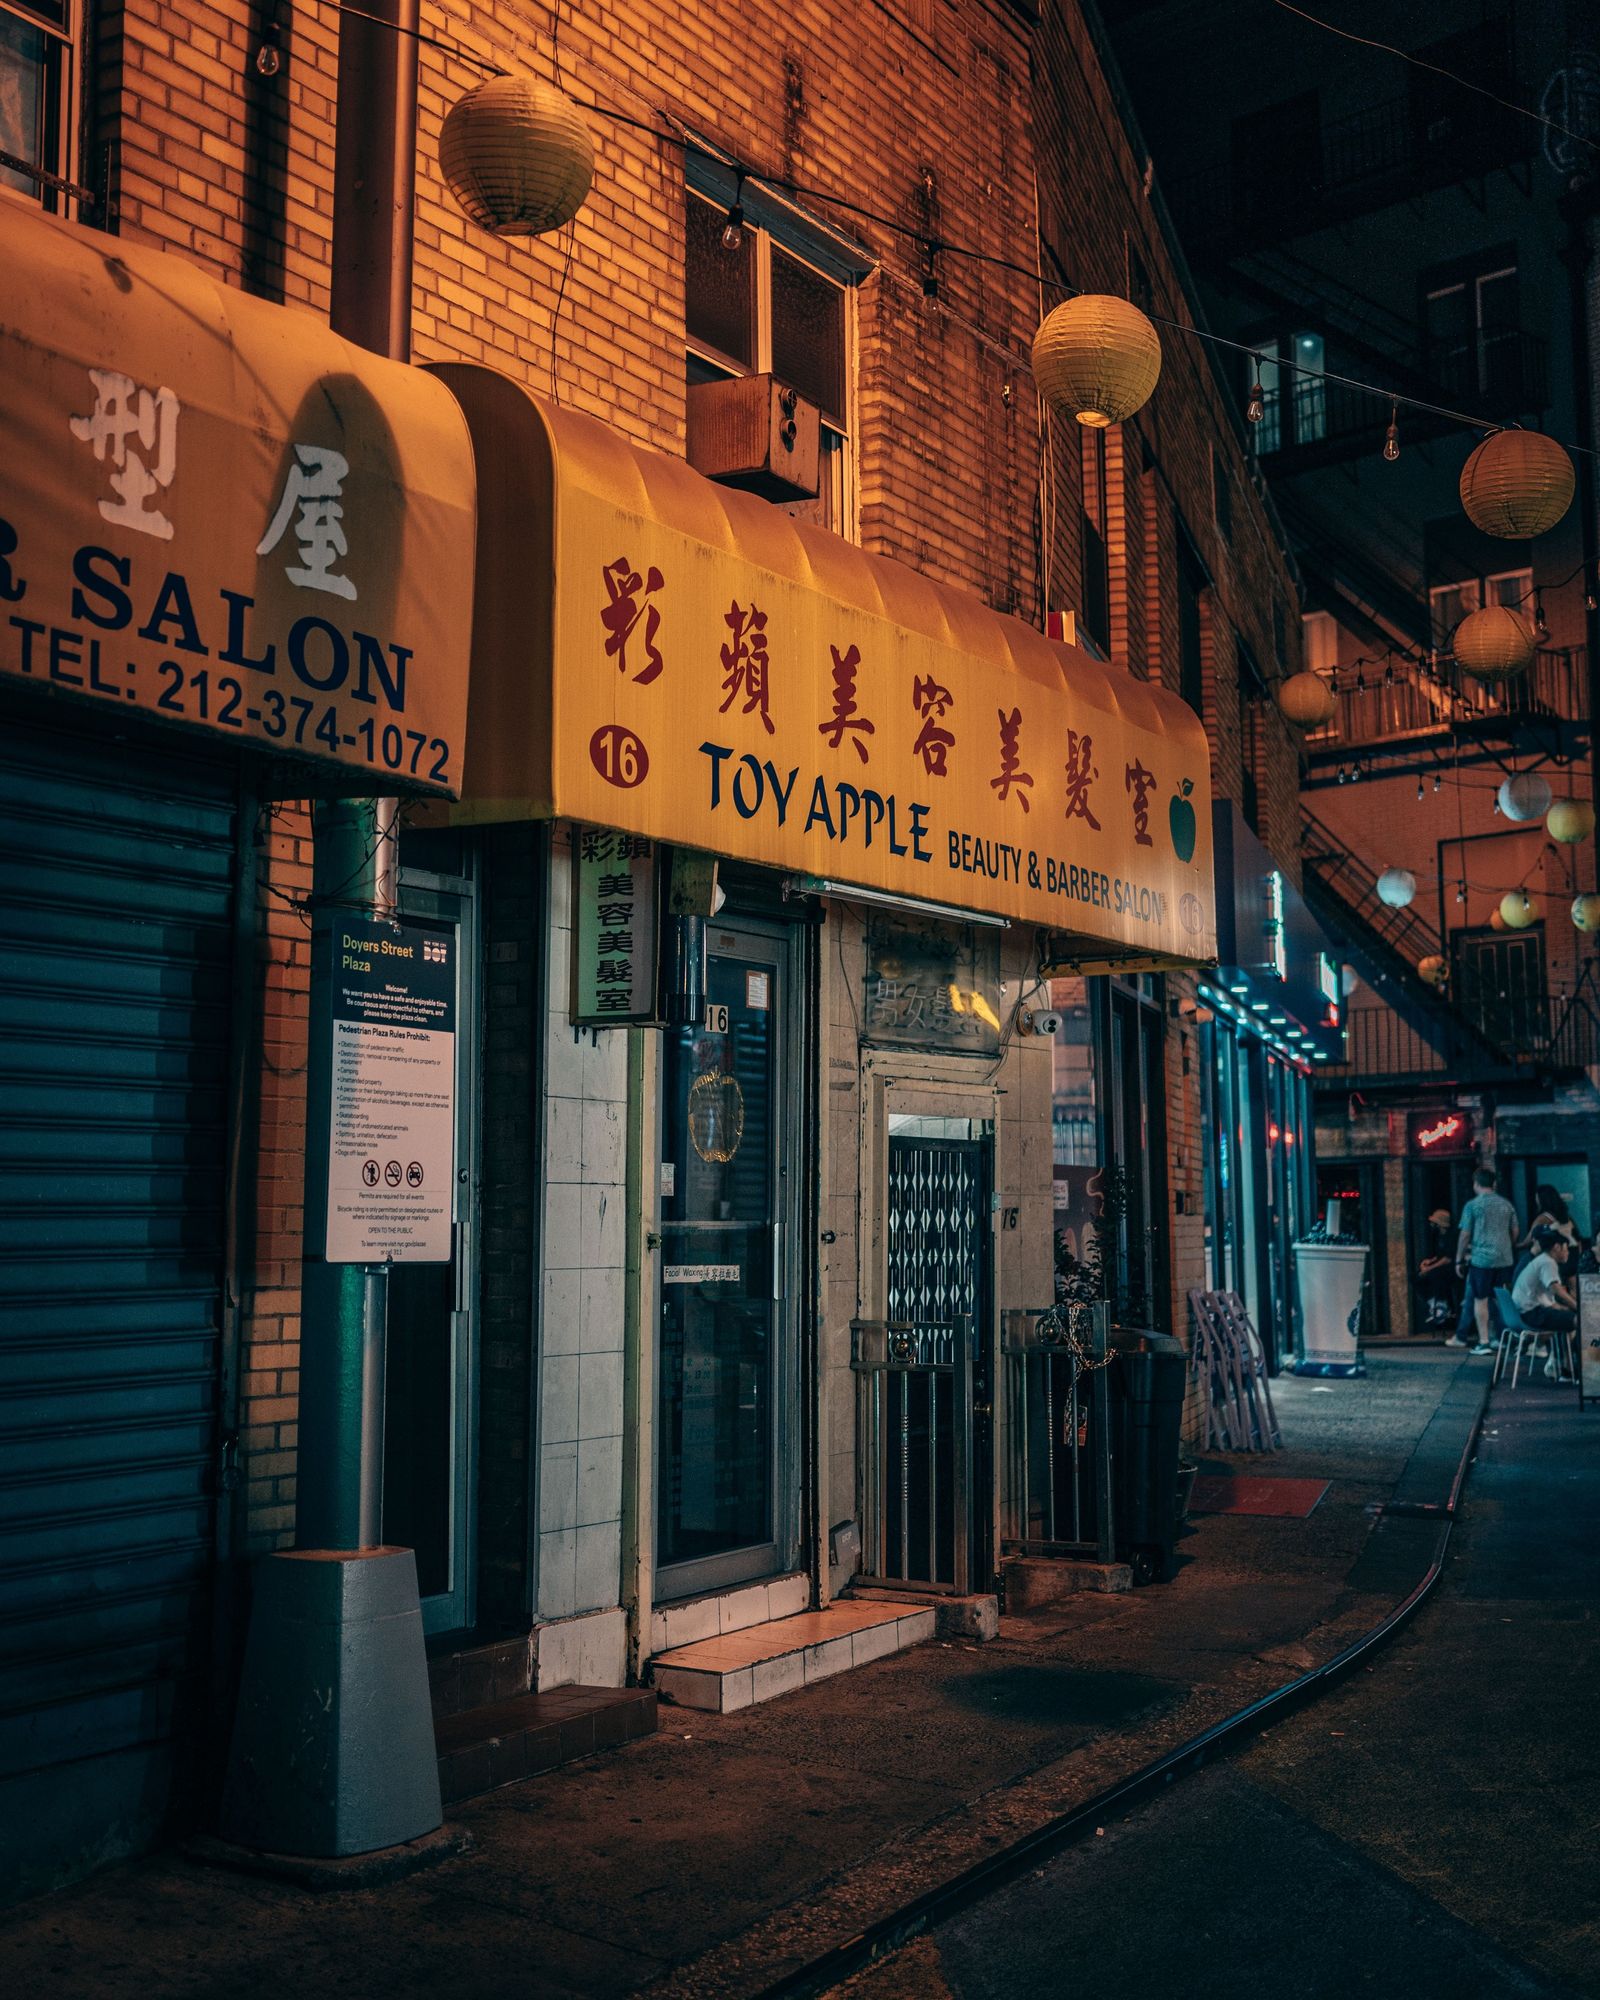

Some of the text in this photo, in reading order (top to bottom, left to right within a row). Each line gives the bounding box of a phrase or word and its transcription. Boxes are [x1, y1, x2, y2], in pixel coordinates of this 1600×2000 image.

[70, 368, 358, 601] 型屋
[71, 546, 413, 713] SALON
[9, 616, 450, 784] TEL: 212-374-1072
[600, 730, 638, 784] 16
[699, 741, 800, 828] TOY
[804, 774, 934, 864] APPLE
[948, 830, 1022, 885] BEAUTY
[1026, 850, 1042, 888] &
[1046, 857, 1111, 909] BARBER
[1114, 878, 1162, 926] SALON
[342, 934, 413, 957] Doyers Street
[423, 946, 446, 962] DOT
[595, 872, 635, 1012] 美容美髮室
[342, 954, 370, 971] Plaza
[385, 984, 407, 993] Welcome!
[708, 1007, 727, 1031] 16
[338, 1024, 430, 1041] Pedestrian Plaza Rules Prohibit:
[1003, 1208, 1019, 1229] 16
